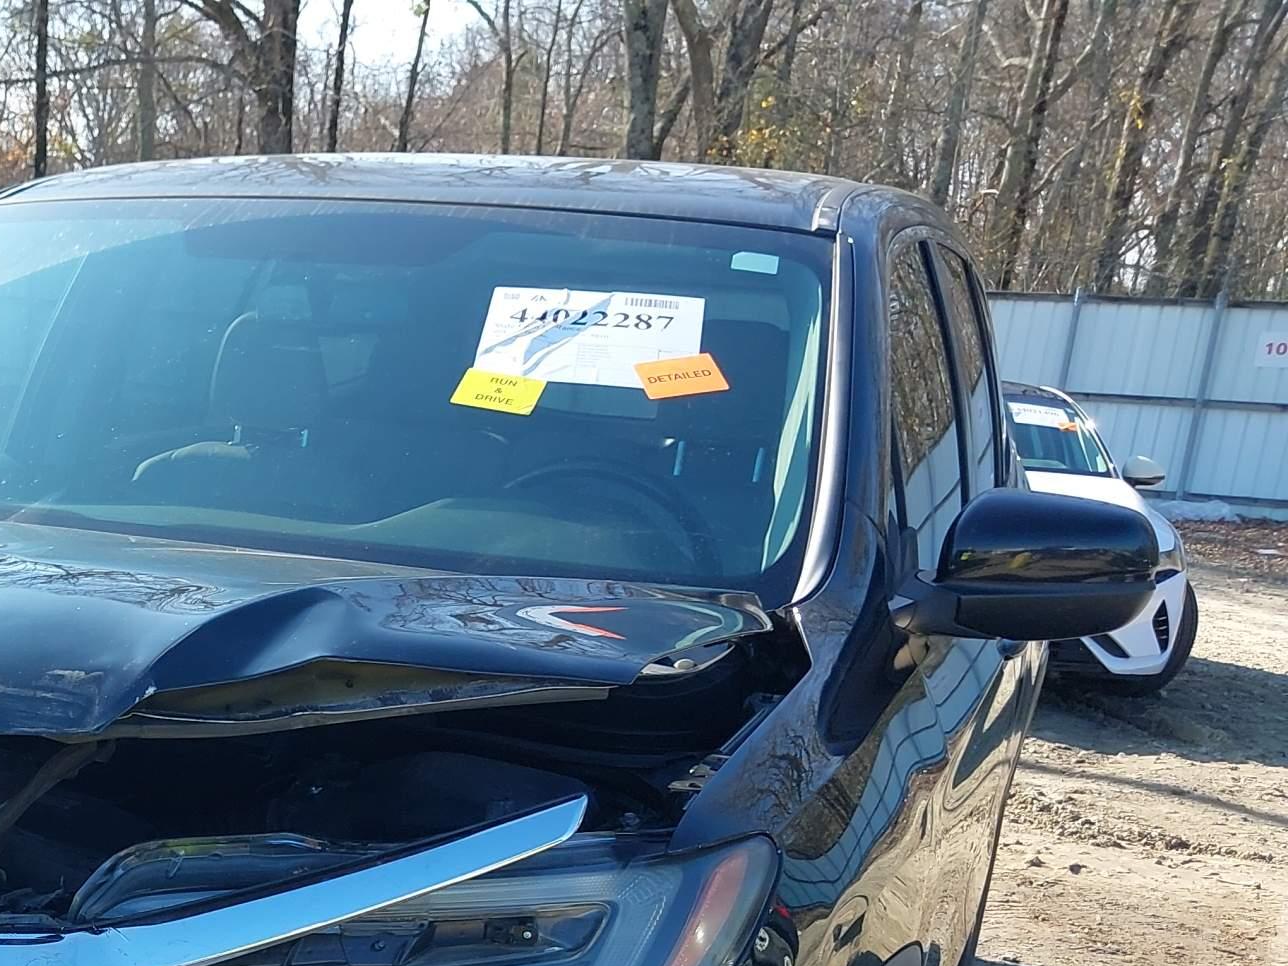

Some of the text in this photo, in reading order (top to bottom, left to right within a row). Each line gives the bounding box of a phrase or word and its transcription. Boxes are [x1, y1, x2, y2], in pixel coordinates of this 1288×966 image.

[490, 376, 518, 388] RUN
[647, 368, 713, 384] DETAILED
[474, 393, 514, 406] DRIVE
